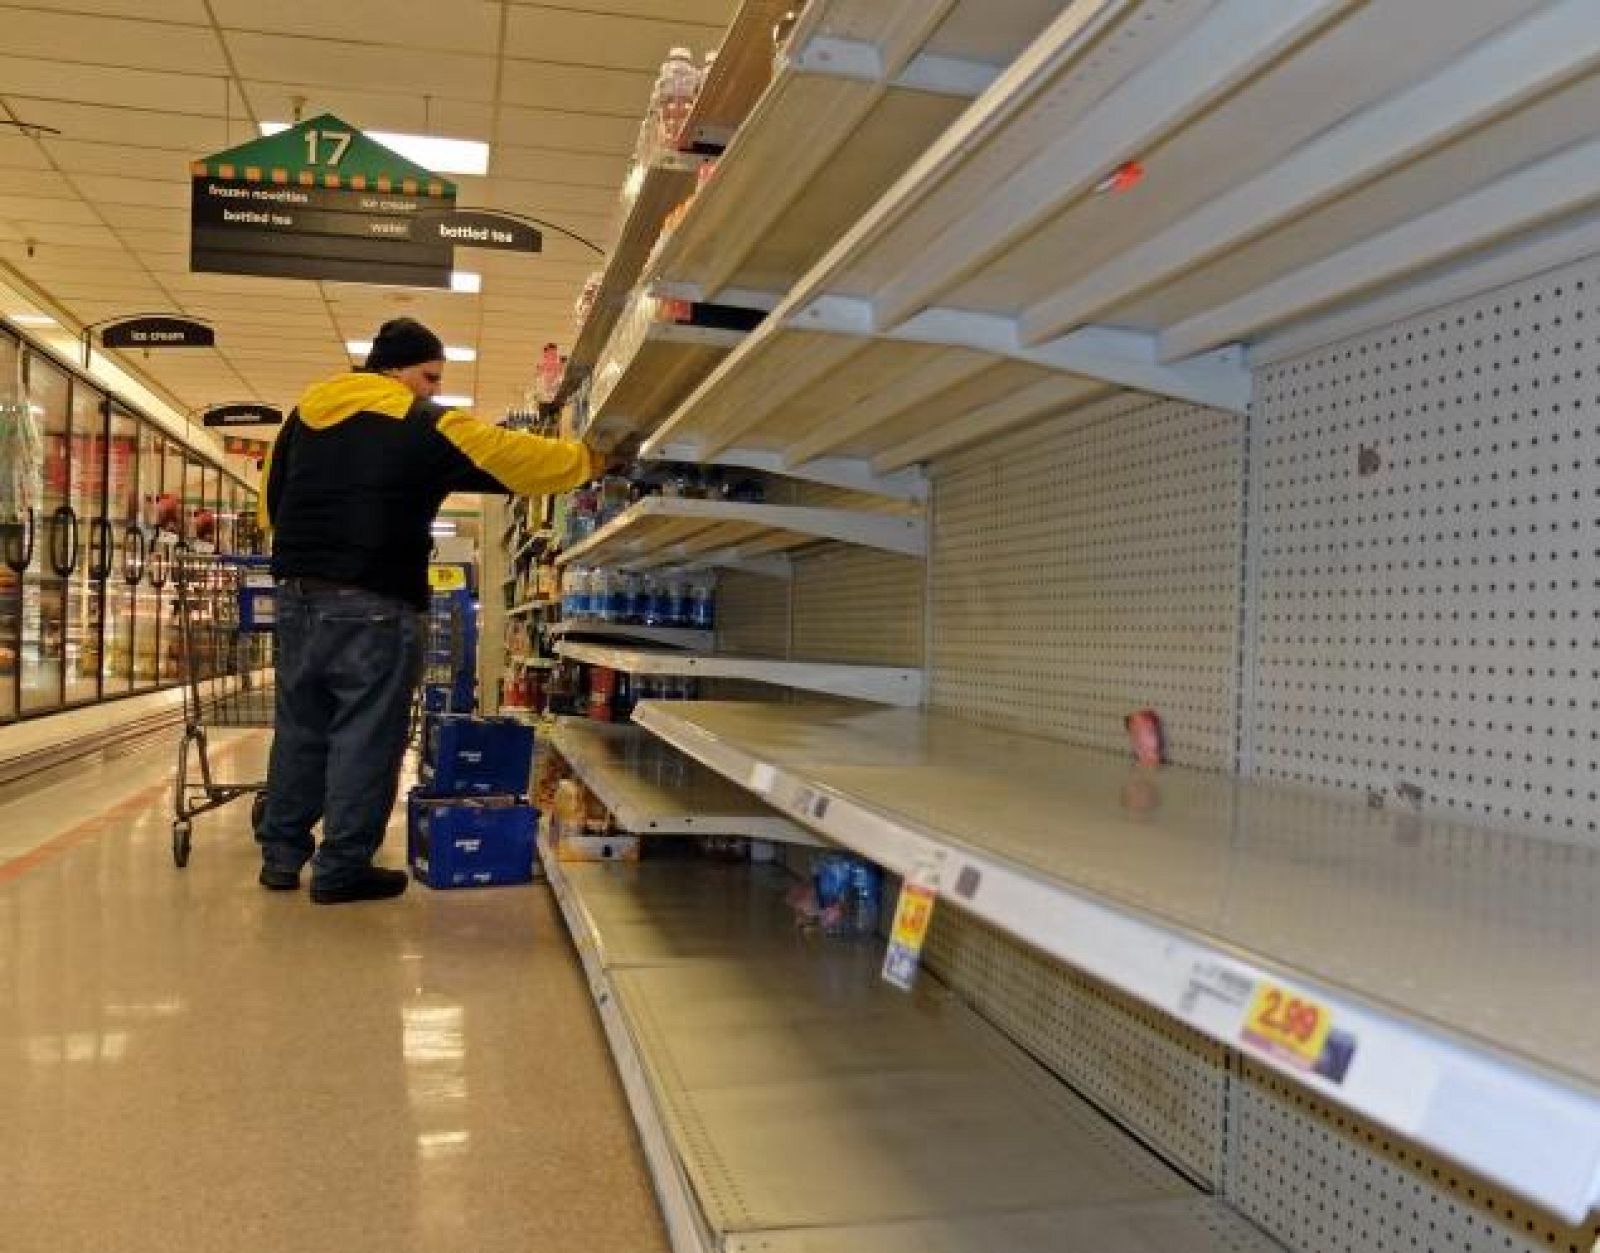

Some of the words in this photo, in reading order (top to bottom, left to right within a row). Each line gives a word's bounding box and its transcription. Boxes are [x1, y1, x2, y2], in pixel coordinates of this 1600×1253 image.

[304, 129, 352, 166] 17
[223, 208, 270, 223] bottled
[440, 223, 489, 241] bottled
[491, 229, 513, 243] tea
[1257, 987, 1320, 1044] 2.99
